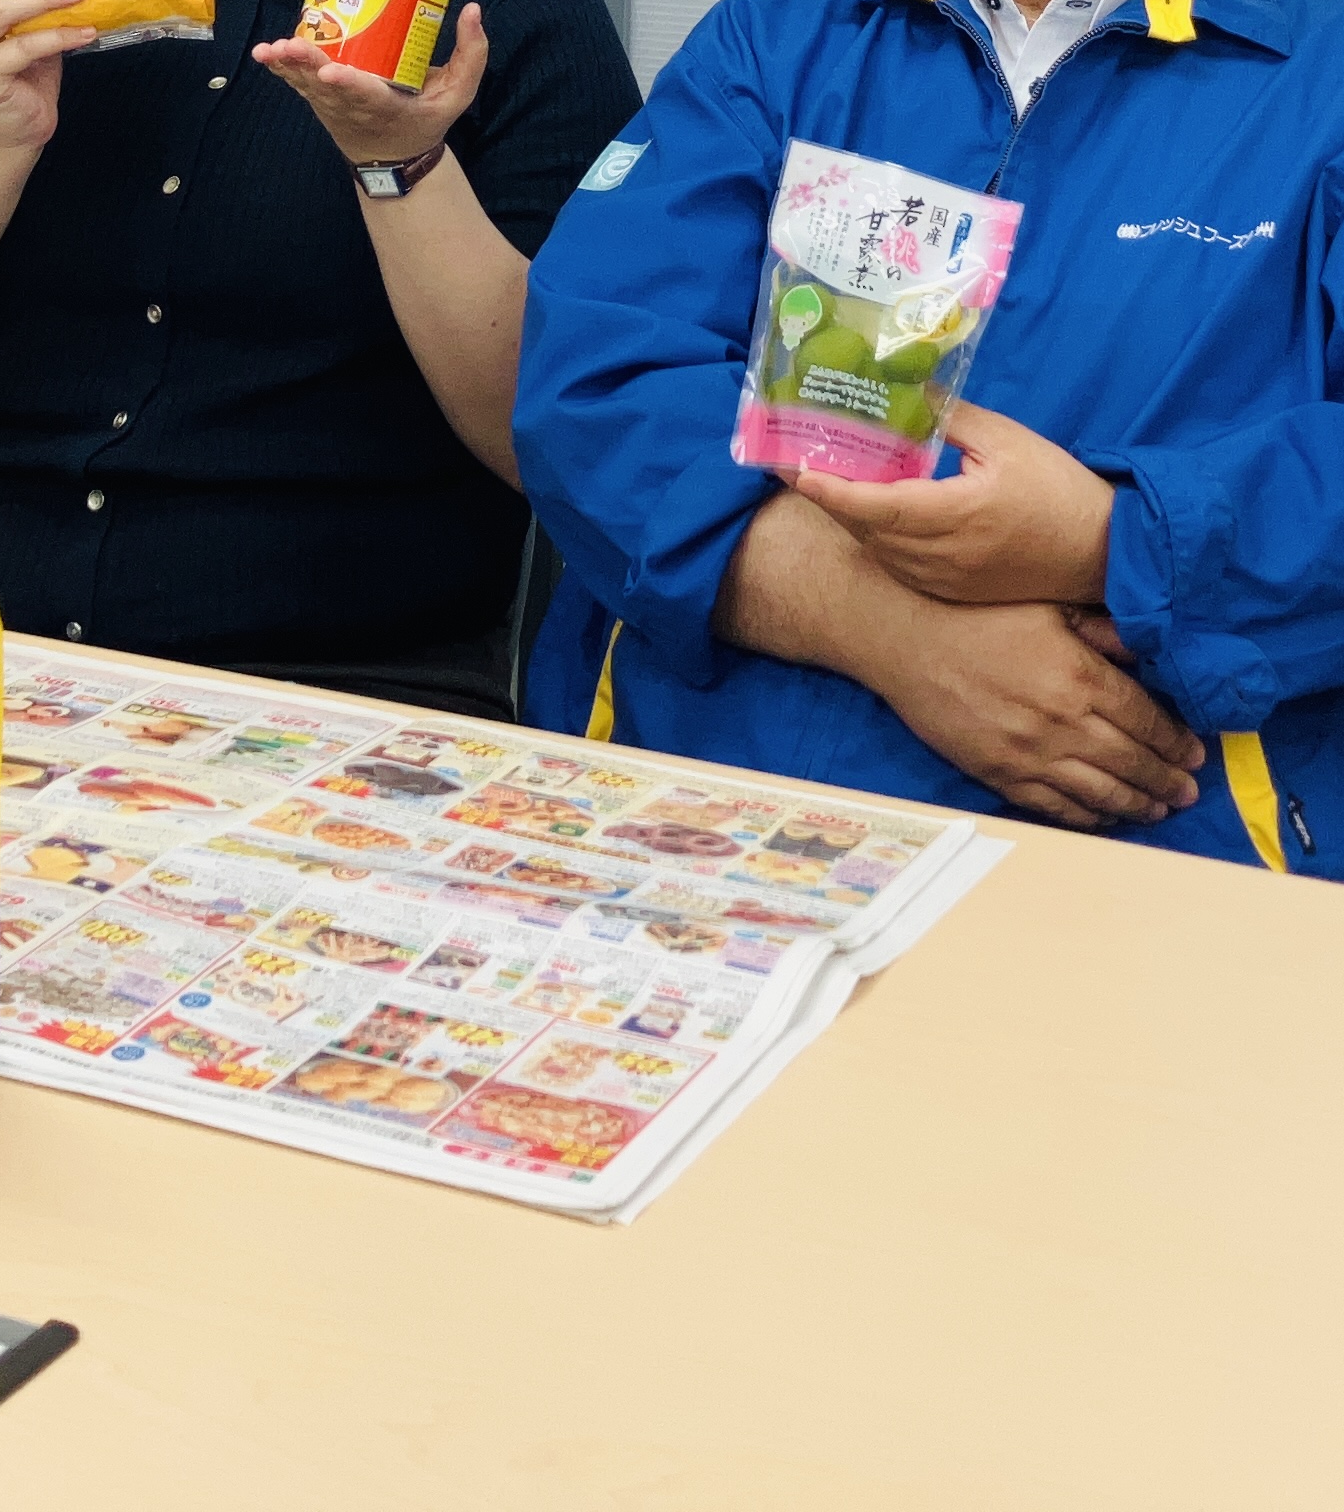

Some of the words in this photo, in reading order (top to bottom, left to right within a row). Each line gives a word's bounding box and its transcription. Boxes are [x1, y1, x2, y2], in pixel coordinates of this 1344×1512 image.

[848, 208, 890, 292] 甘露煮
[924, 205, 949, 248] 国産
